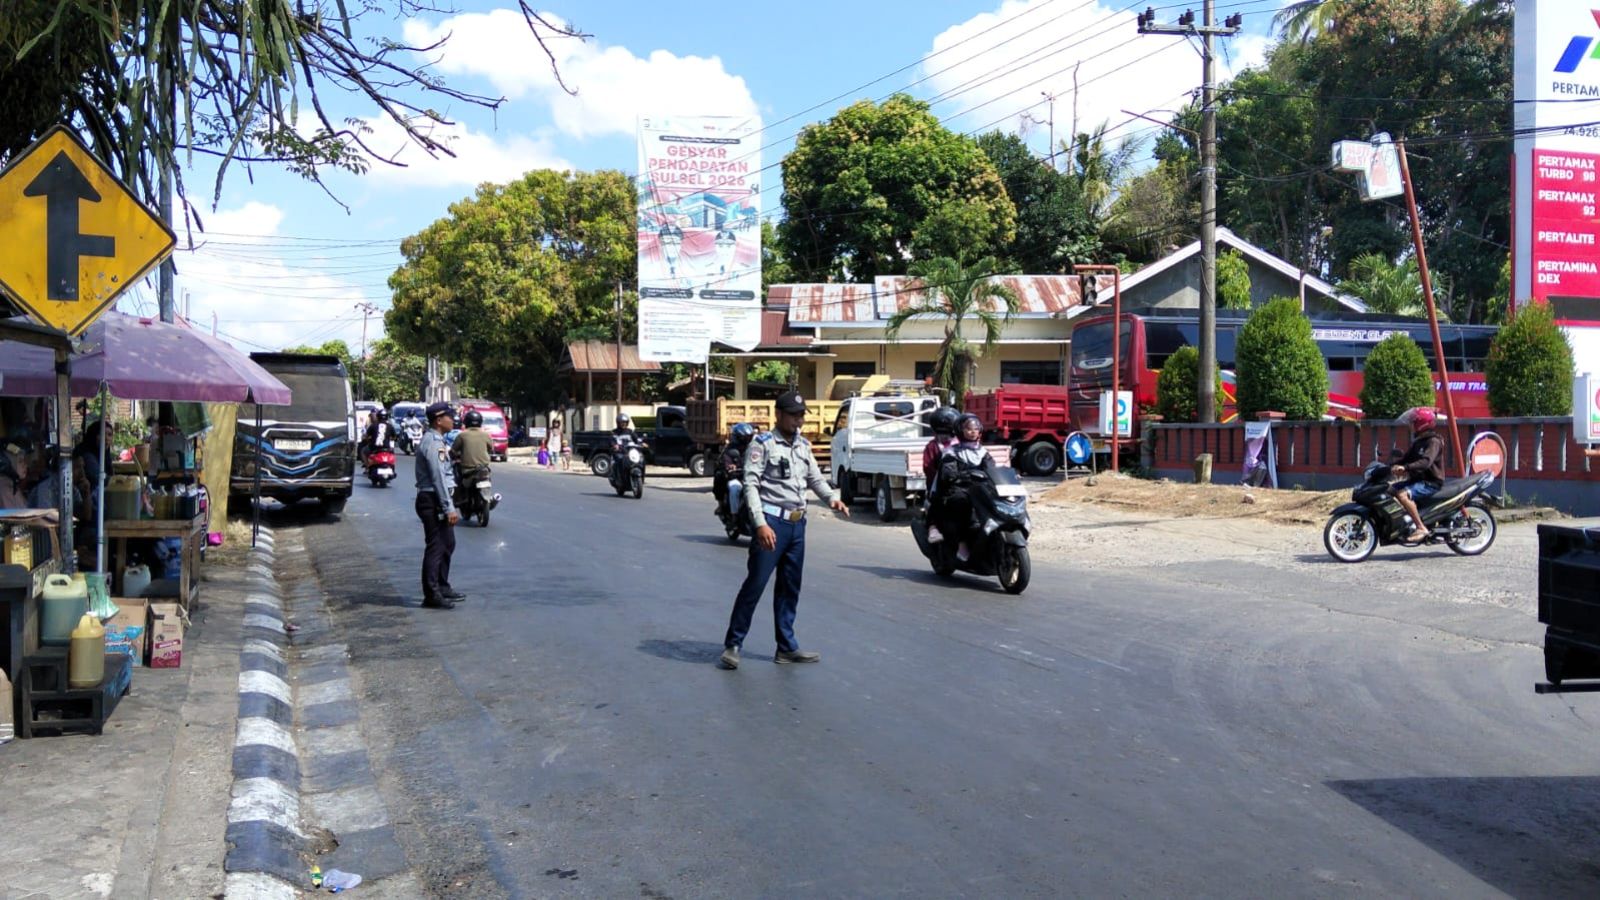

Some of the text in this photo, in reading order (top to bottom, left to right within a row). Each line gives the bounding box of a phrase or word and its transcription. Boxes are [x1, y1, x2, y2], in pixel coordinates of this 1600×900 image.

[1552, 81, 1599, 97] PERTAM
[648, 158, 748, 173] PENDAPATAN
[1538, 155, 1595, 169] PERTAMAX
[650, 172, 705, 185] SULSEL
[1539, 167, 1596, 182] TURBO 98
[1538, 190, 1595, 203] PERTAMAX
[1583, 206, 1596, 216] 92
[1538, 231, 1595, 244] PERTALITE
[1538, 260, 1598, 273] PERTAMINA
[1537, 273, 1560, 284] DEX
